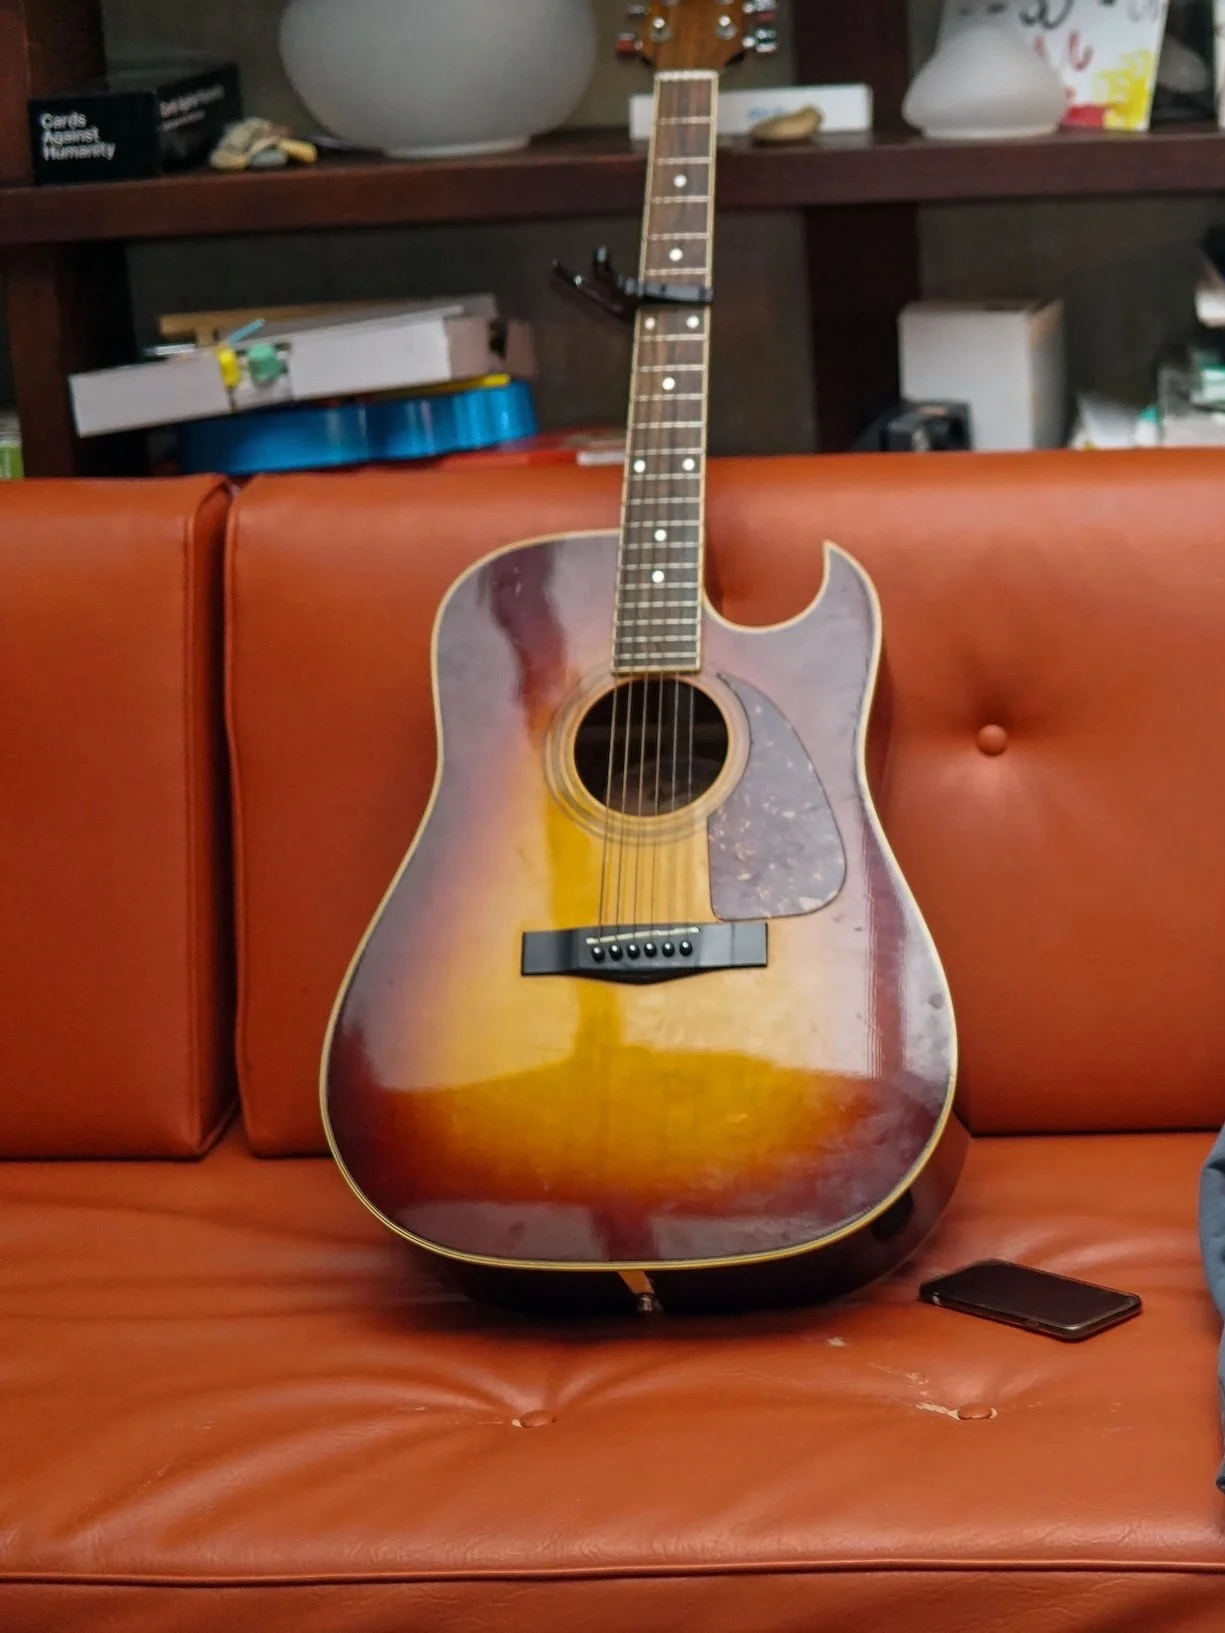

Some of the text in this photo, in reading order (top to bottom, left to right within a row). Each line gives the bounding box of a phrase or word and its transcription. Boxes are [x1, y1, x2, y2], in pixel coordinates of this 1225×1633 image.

[41, 112, 87, 130] Cards
[43, 126, 99, 146] Against
[43, 142, 116, 161] Humanity
